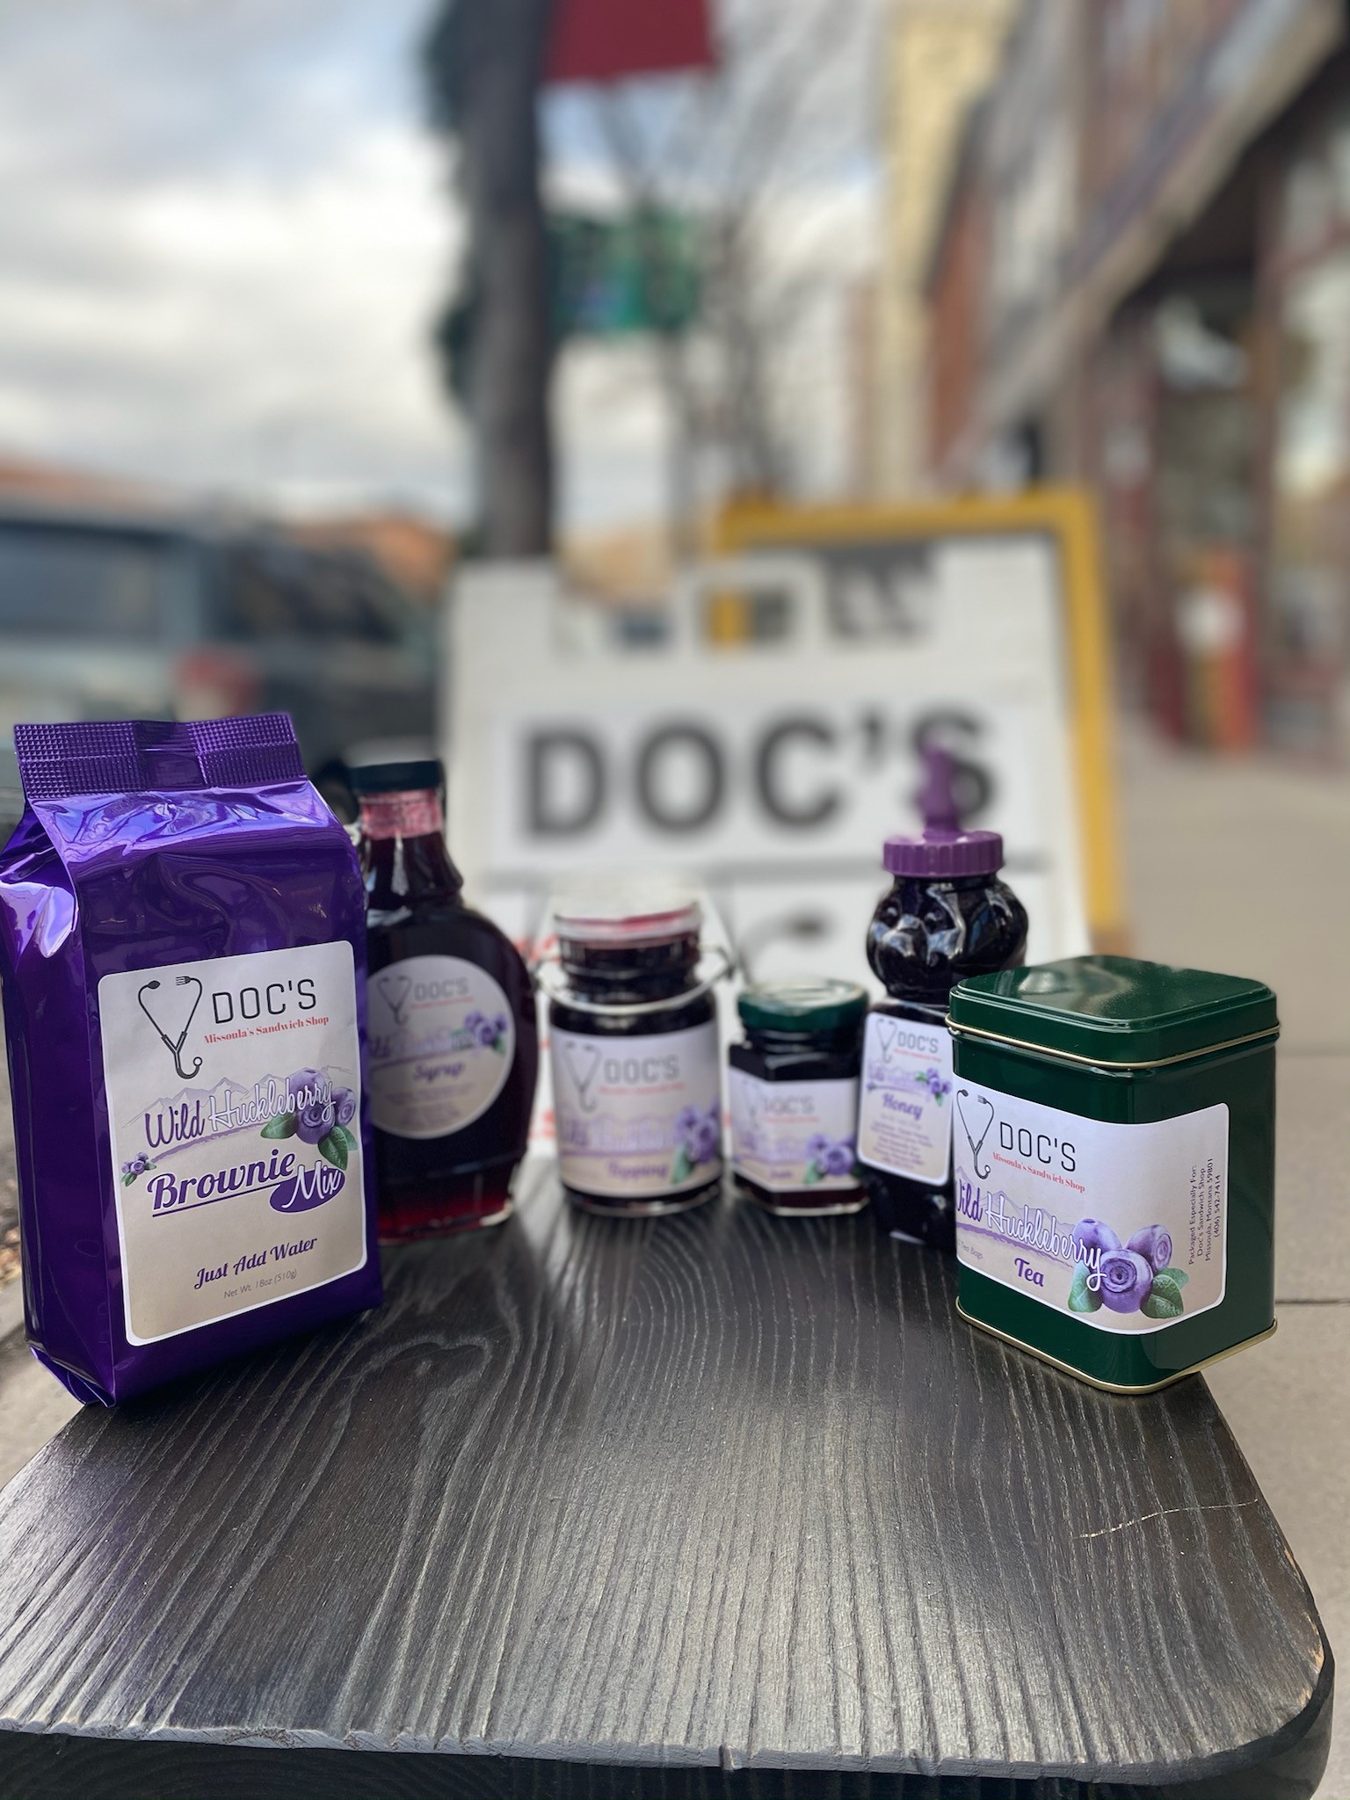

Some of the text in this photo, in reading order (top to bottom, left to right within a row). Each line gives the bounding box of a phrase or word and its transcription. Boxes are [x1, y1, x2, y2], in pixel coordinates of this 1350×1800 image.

[518, 706, 996, 840] DOC'S
[211, 978, 317, 1024] DOC'S
[204, 1014, 330, 1045] Missoula's Sandwich Shop
[897, 1031, 939, 1054] DOC'S
[145, 1099, 205, 1149] Wild
[208, 1077, 336, 1132] Huckleberry
[882, 1092, 924, 1121] Honey
[1000, 1121, 1076, 1172] DOC'S
[147, 1149, 342, 1211] Brownie Mix
[992, 1151, 1086, 1194] Missoula's Sandwich Shop
[1198, 1168, 1206, 1189] Shop
[1206, 1158, 1214, 1183] 59801
[1189, 1185, 1198, 1225] Especially
[1197, 1191, 1205, 1230] Sandwich
[957, 1178, 1108, 1292] ild Huckleberry
[1188, 1227, 1197, 1265] Packaged
[1213, 1215, 1221, 1238] (406)
[193, 1237, 318, 1290] Just Add Water
[1014, 1257, 1044, 1288] Tea
[223, 1287, 238, 1299] Net
[255, 1277, 272, 1289] 18oz
[273, 1268, 298, 1286] (510g)
